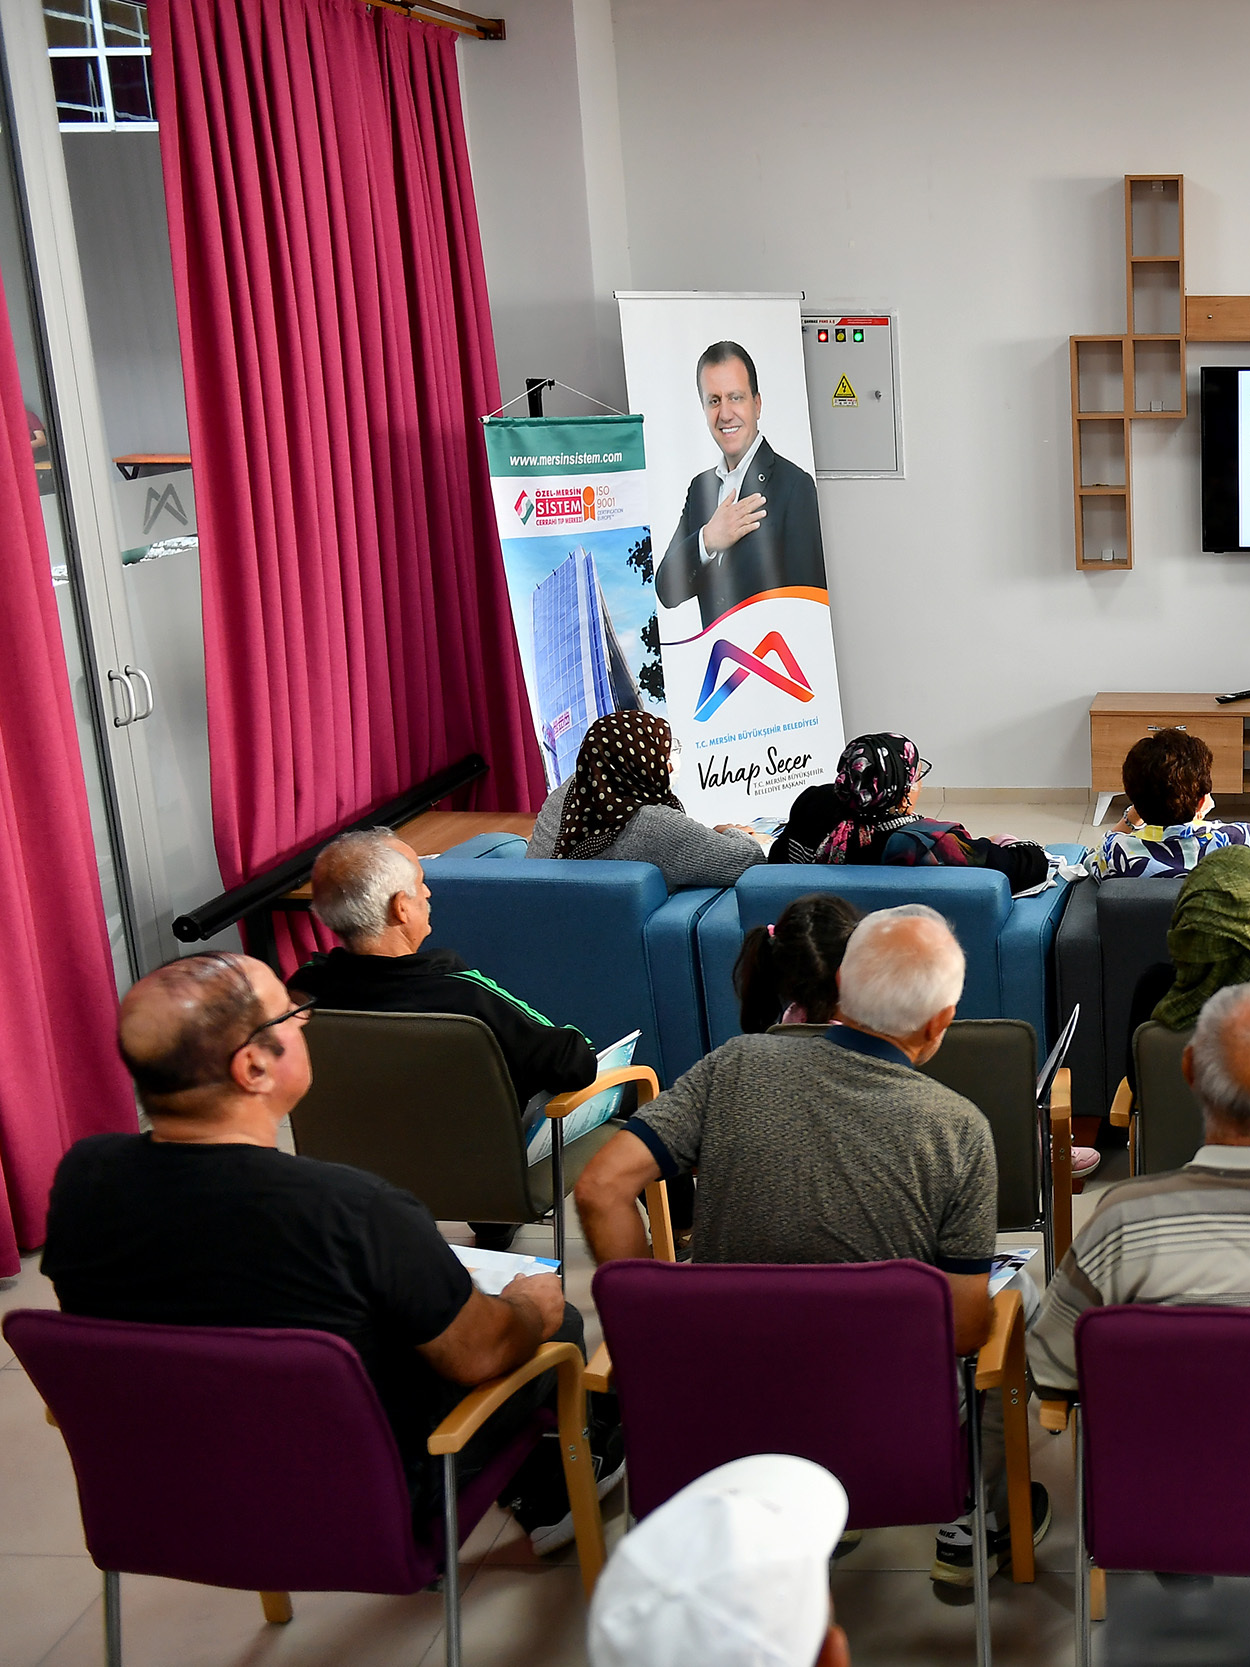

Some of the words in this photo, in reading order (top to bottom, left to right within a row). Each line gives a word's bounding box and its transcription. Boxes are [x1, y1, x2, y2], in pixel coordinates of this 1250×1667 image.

[509, 451, 623, 466] www.mersinsistem.com
[535, 486, 582, 497] ÖZEL-MERSİN
[596, 485, 610, 496] ISO
[537, 499, 581, 515] SİSTEM
[597, 497, 616, 508] 9001
[535, 517, 557, 526] CERRAHİ
[695, 741, 708, 749] T.C.
[709, 732, 736, 746] MERSİN
[738, 724, 782, 741] BÜYÜKŞEHİR
[783, 716, 819, 731] BELEDİYESİ
[698, 754, 761, 795] Vahap
[765, 745, 812, 776] Seçer
[766, 776, 787, 787] MERSİN
[788, 768, 825, 781] BÜYÜKŞEHİR
[754, 786, 781, 796] BELEDİYE
[782, 779, 806, 790] BAŞKANI
[938, 1529, 957, 1539] NIKE
